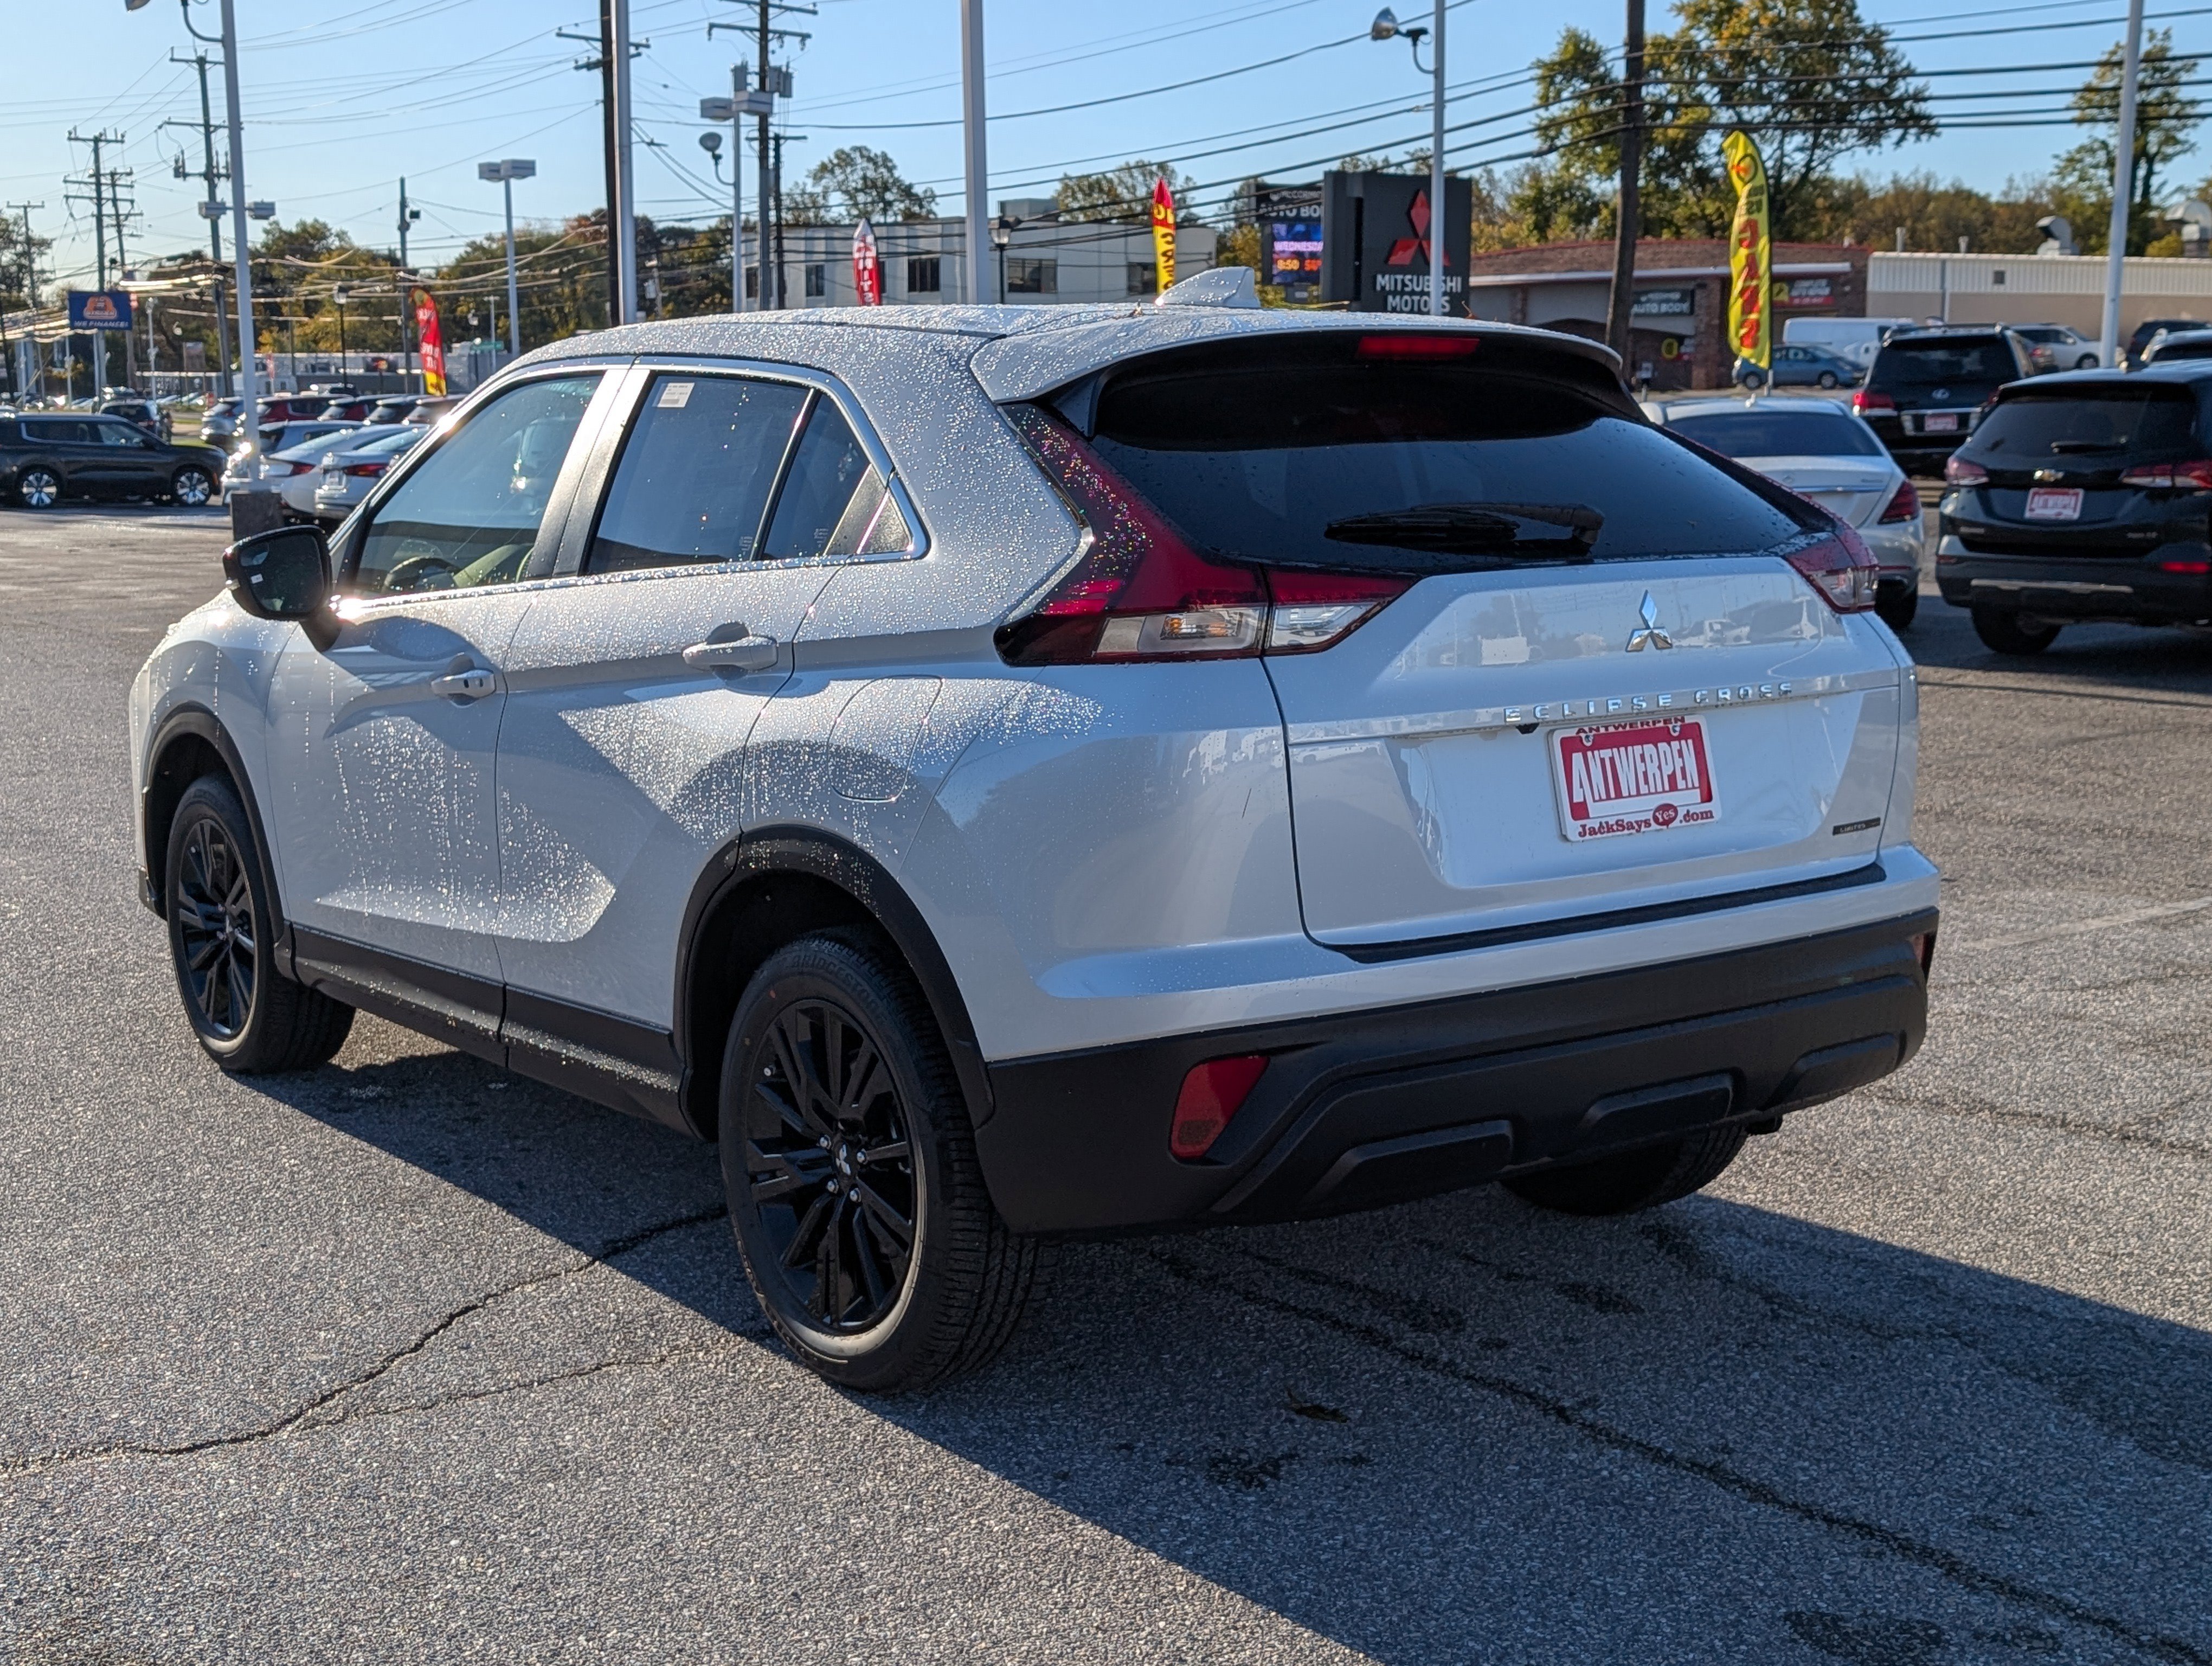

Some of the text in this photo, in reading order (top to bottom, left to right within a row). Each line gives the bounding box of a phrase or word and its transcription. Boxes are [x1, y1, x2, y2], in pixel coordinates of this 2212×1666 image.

[1376, 274, 1462, 293] MITSUBSHI
[1387, 294, 1451, 312] MOTOS
[1504, 682, 1792, 722] ECLIPSE CROSS
[1576, 715, 1686, 735] ANTWERPEN
[1572, 739, 1700, 803] ANTWERPEN
